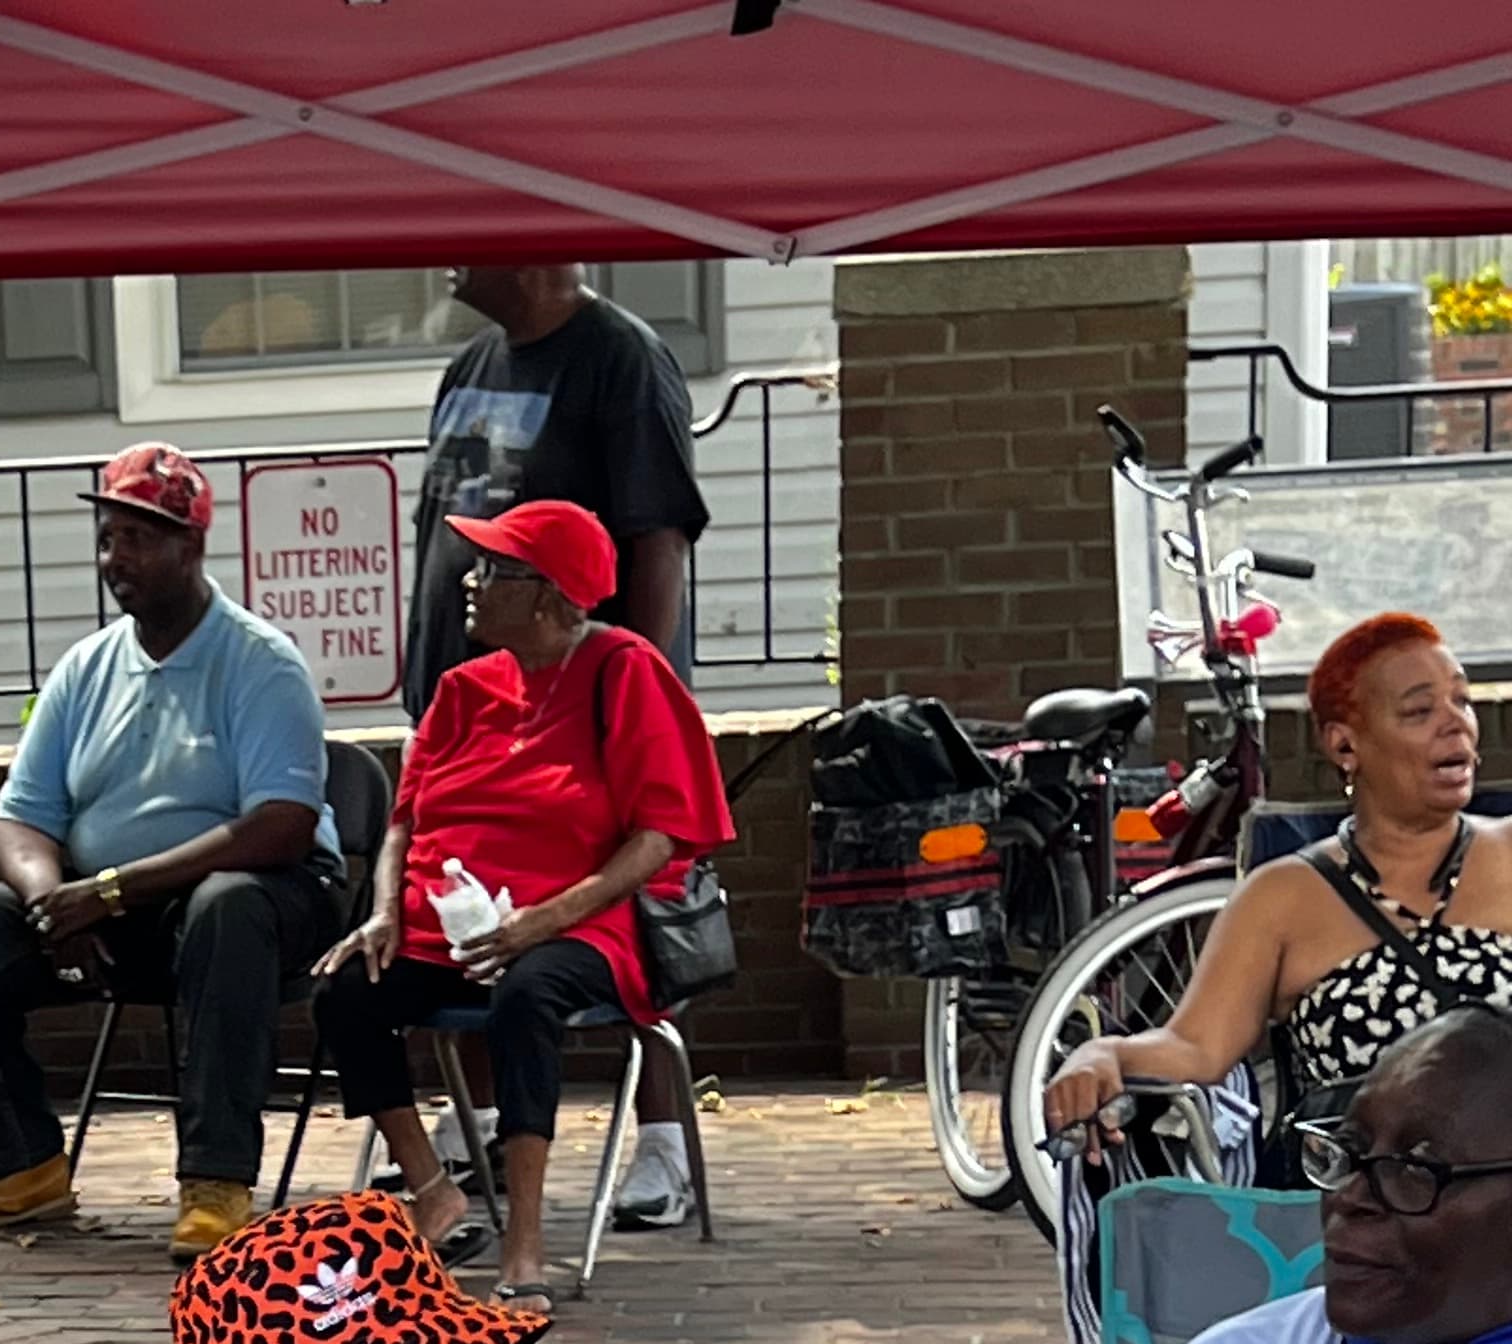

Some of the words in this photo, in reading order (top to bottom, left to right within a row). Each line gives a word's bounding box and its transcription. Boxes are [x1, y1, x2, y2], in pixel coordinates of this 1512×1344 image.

[300, 507, 338, 537] NO
[255, 545, 387, 580] LITTERING
[261, 586, 385, 620] SUBJECT
[321, 626, 384, 658] FINE
